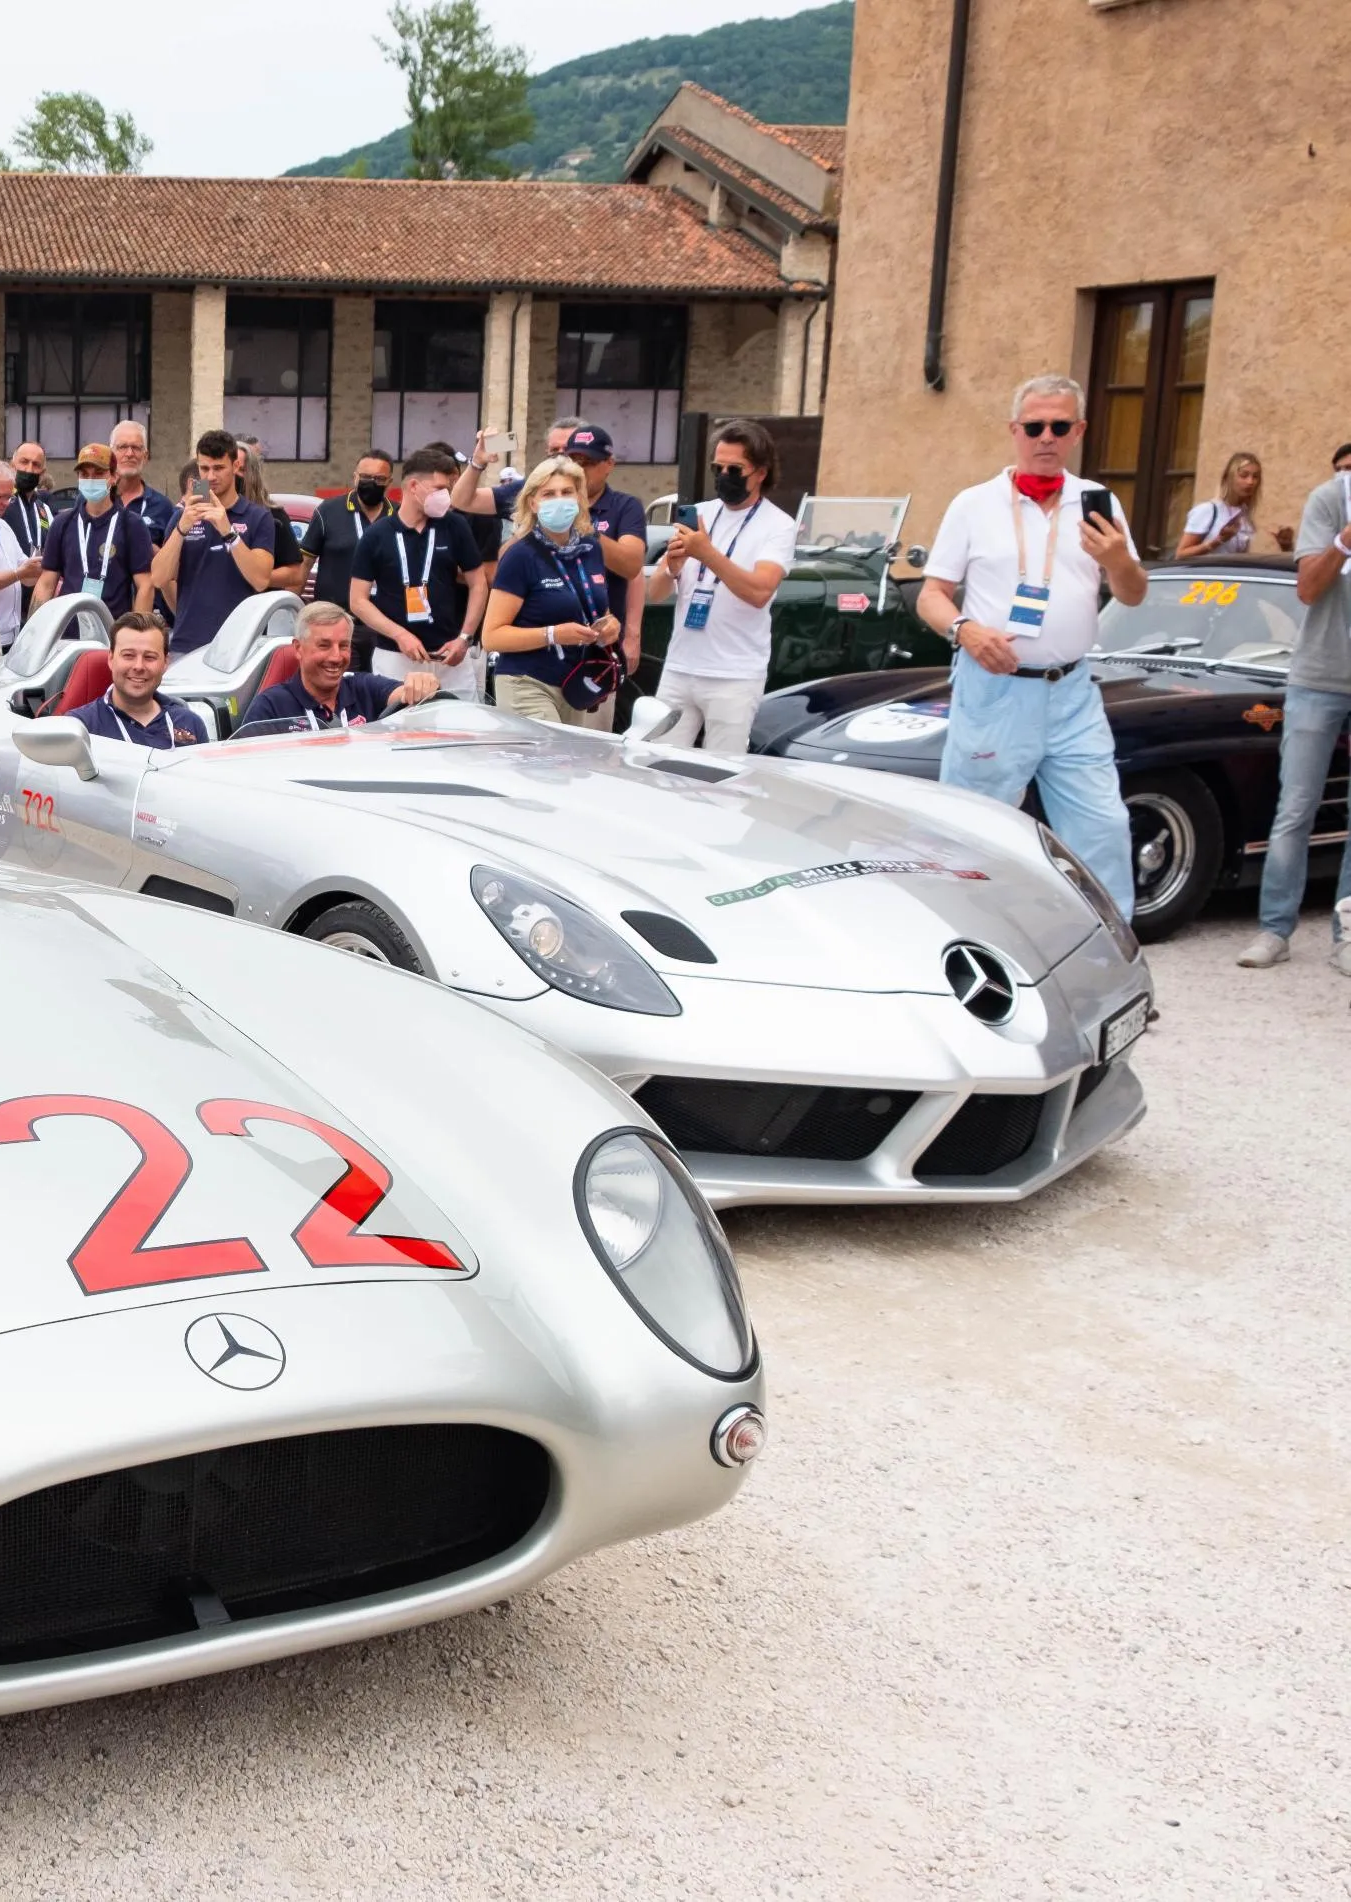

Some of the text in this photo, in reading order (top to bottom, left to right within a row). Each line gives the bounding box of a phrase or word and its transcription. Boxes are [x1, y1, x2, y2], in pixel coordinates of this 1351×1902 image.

[1178, 580, 1242, 606] 296
[21, 788, 61, 833] 722
[710, 875, 797, 905] OFFICIAL
[800, 862, 857, 880] MILLE
[858, 860, 922, 870] MIGLIA
